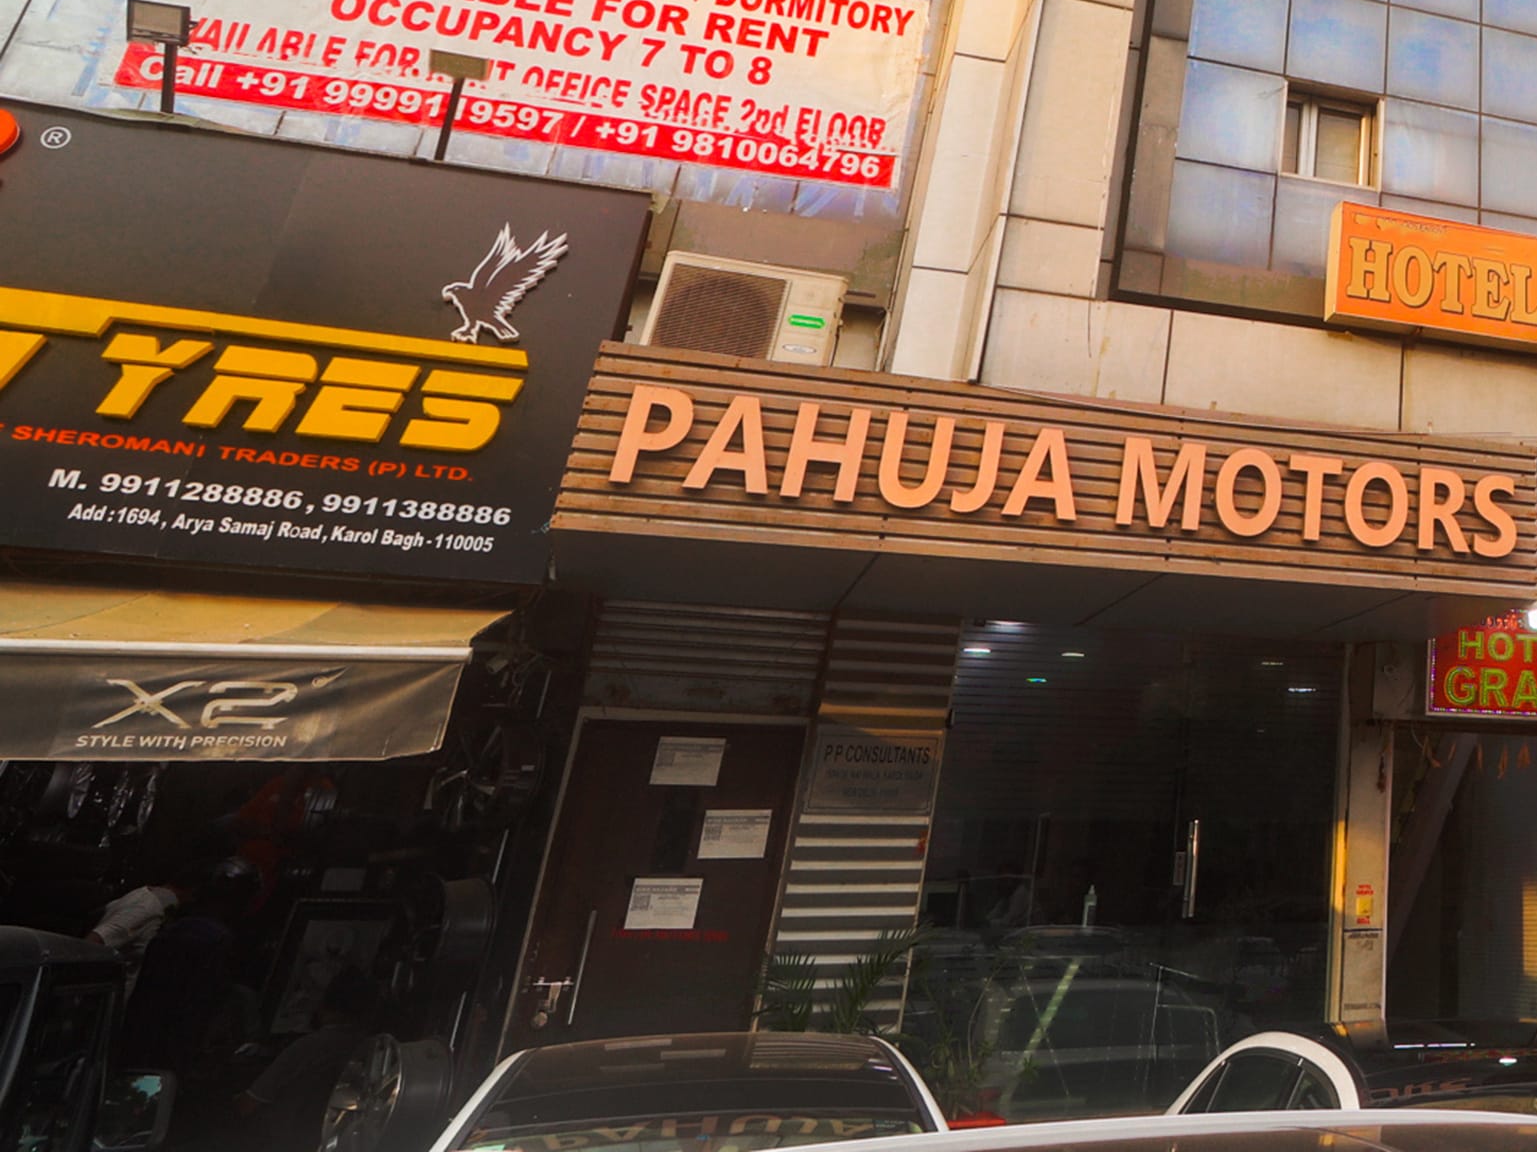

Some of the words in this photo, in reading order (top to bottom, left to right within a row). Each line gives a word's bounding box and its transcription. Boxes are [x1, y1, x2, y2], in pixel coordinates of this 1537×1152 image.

[703, 12, 829, 57] RENT
[641, 38, 666, 68] 7
[680, 45, 735, 79] TO
[747, 57, 773, 86] 8
[139, 55, 222, 90] Call
[237, 69, 310, 100] +91
[596, 122, 657, 149] +91
[672, 132, 880, 179] 9810064796
[11, 425, 206, 457] SHEROMANI
[220, 446, 361, 472] TRADERS
[368, 459, 408, 479] (P)
[414, 462, 475, 482] LTD.
[608, 384, 1077, 522] PAHUJA
[1114, 435, 1518, 558] MOTORS
[48, 468, 88, 491] M.
[321, 493, 512, 527] 9911388886
[171, 513, 215, 536] Arya
[218, 517, 275, 541] Samaj
[277, 520, 328, 545] Road,
[330, 524, 378, 545] Karol
[91, 677, 299, 730] X2
[74, 734, 135, 748] STYLE
[138, 734, 188, 750] WITH
[190, 734, 288, 748] PRECISION
[845, 745, 931, 765] CONSULTANTS
